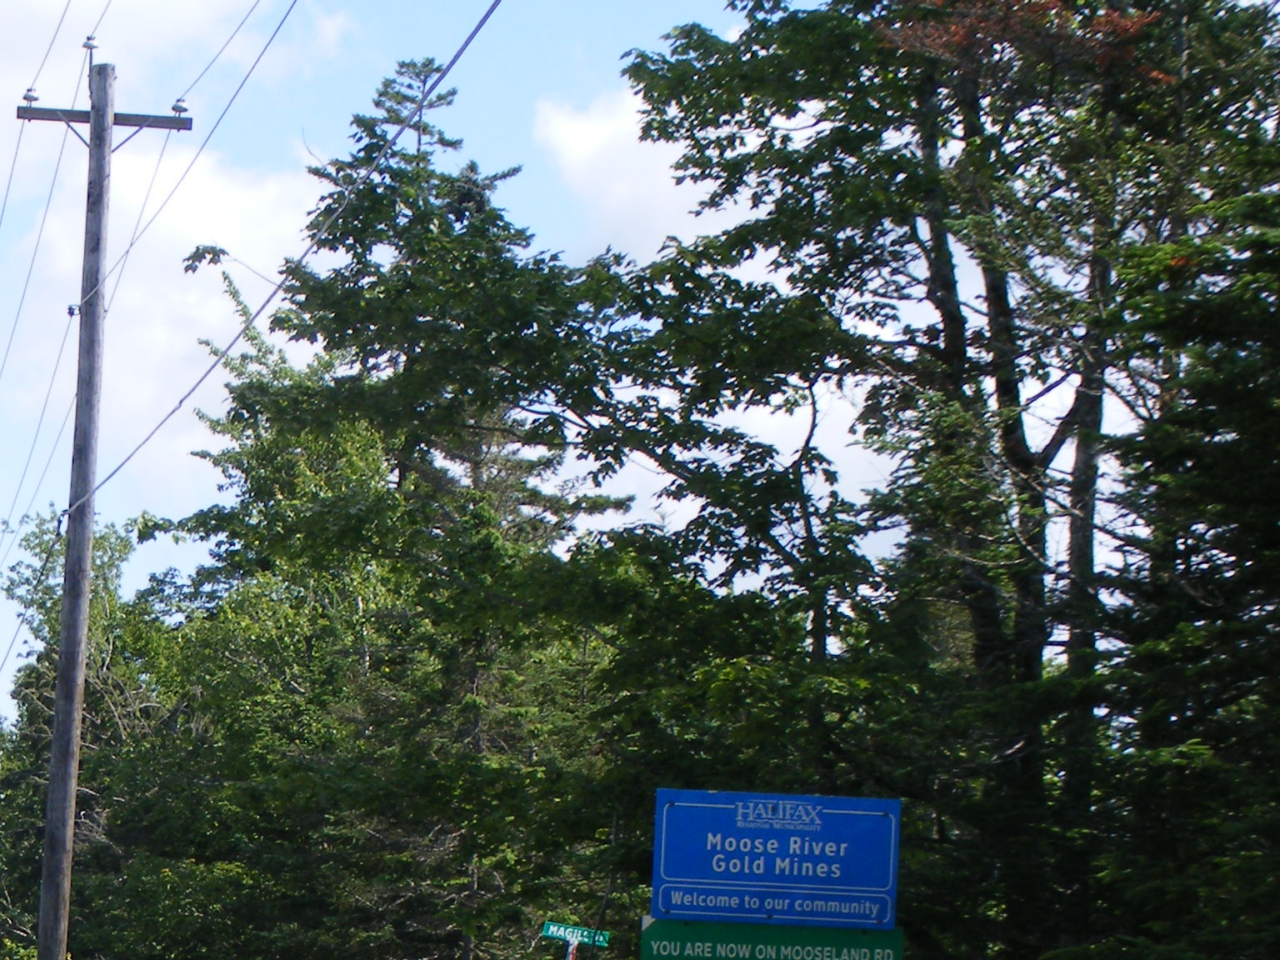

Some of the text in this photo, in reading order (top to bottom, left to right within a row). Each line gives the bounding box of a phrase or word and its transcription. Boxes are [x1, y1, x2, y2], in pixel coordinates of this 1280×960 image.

[735, 801, 823, 824] HALIFAX
[706, 832, 849, 857] Moose River
[712, 854, 841, 878] Gold Mines
[671, 890, 880, 918] Welcome to our community
[651, 941, 680, 956] YOU
[684, 942, 712, 957] ARE
[716, 943, 752, 959] NOW
[755, 944, 777, 960] ON
